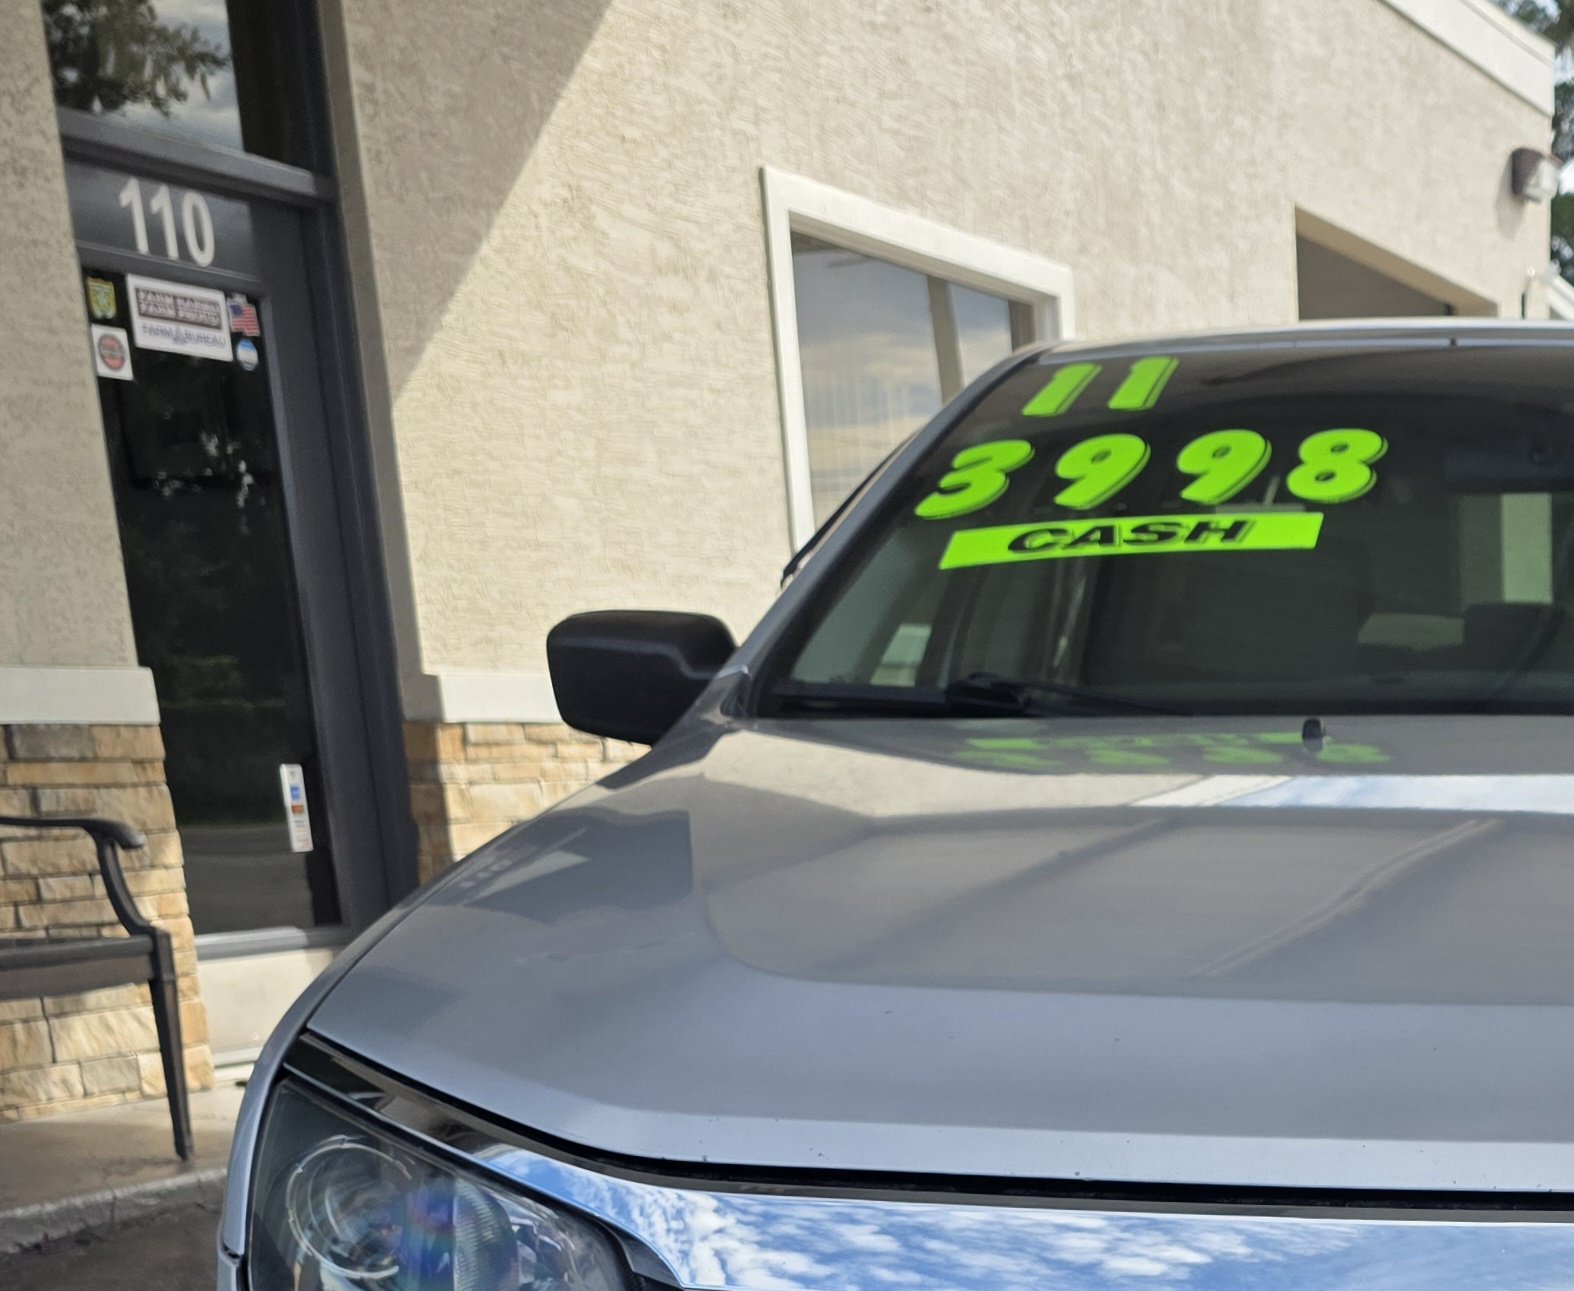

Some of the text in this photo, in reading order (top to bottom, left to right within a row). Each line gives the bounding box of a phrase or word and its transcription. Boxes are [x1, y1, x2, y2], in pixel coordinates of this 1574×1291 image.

[119, 177, 216, 268] 110
[1021, 356, 1180, 417] 11
[914, 428, 1389, 520] 3998
[1006, 519, 1258, 554] CASH
